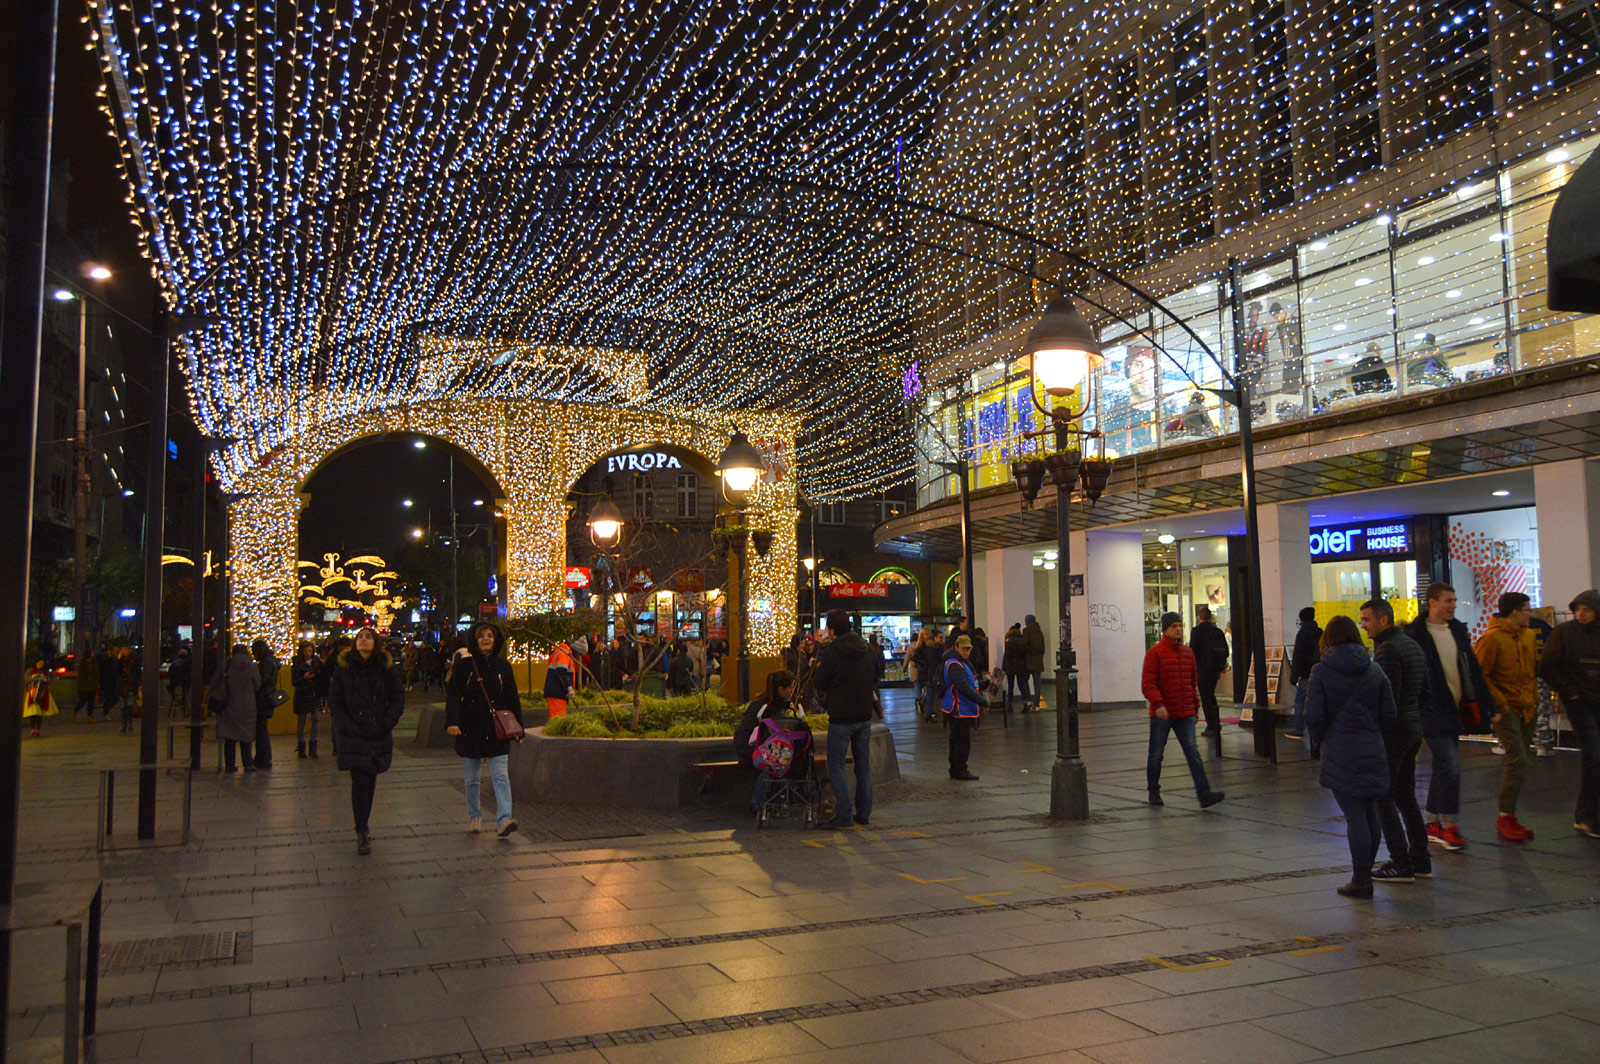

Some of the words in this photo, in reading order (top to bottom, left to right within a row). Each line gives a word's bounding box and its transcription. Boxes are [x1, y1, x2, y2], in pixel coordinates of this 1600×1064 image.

[607, 452, 682, 473] EVROPA
[1366, 524, 1405, 536] BUSINESS
[1366, 536, 1406, 550] HOUSE
